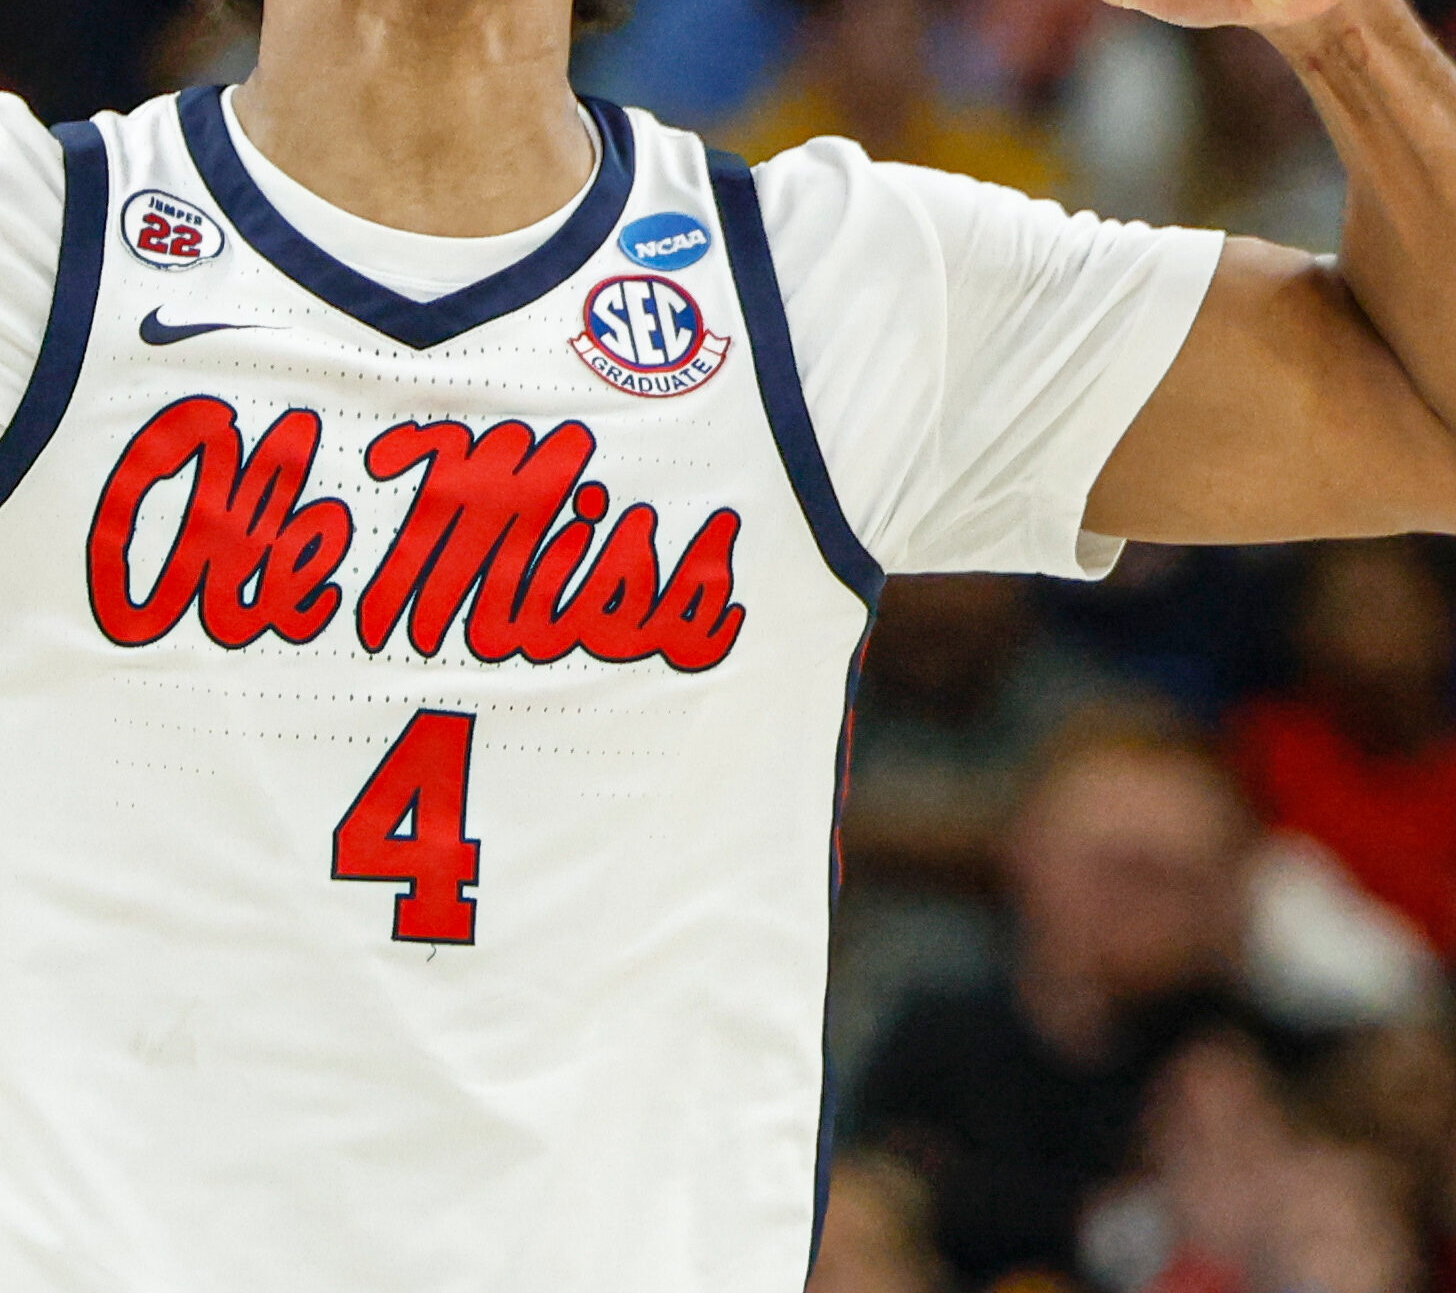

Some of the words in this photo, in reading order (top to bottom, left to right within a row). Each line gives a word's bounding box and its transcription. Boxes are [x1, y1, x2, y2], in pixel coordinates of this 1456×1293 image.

[148, 196, 203, 226] JUMPER
[136, 212, 203, 258] 22
[634, 229, 708, 259] NCAA
[592, 279, 694, 365] SEC
[590, 356, 713, 394] GRADUATE
[86, 395, 354, 650] Ole
[354, 419, 747, 673] Miss
[331, 707, 482, 945] 4
